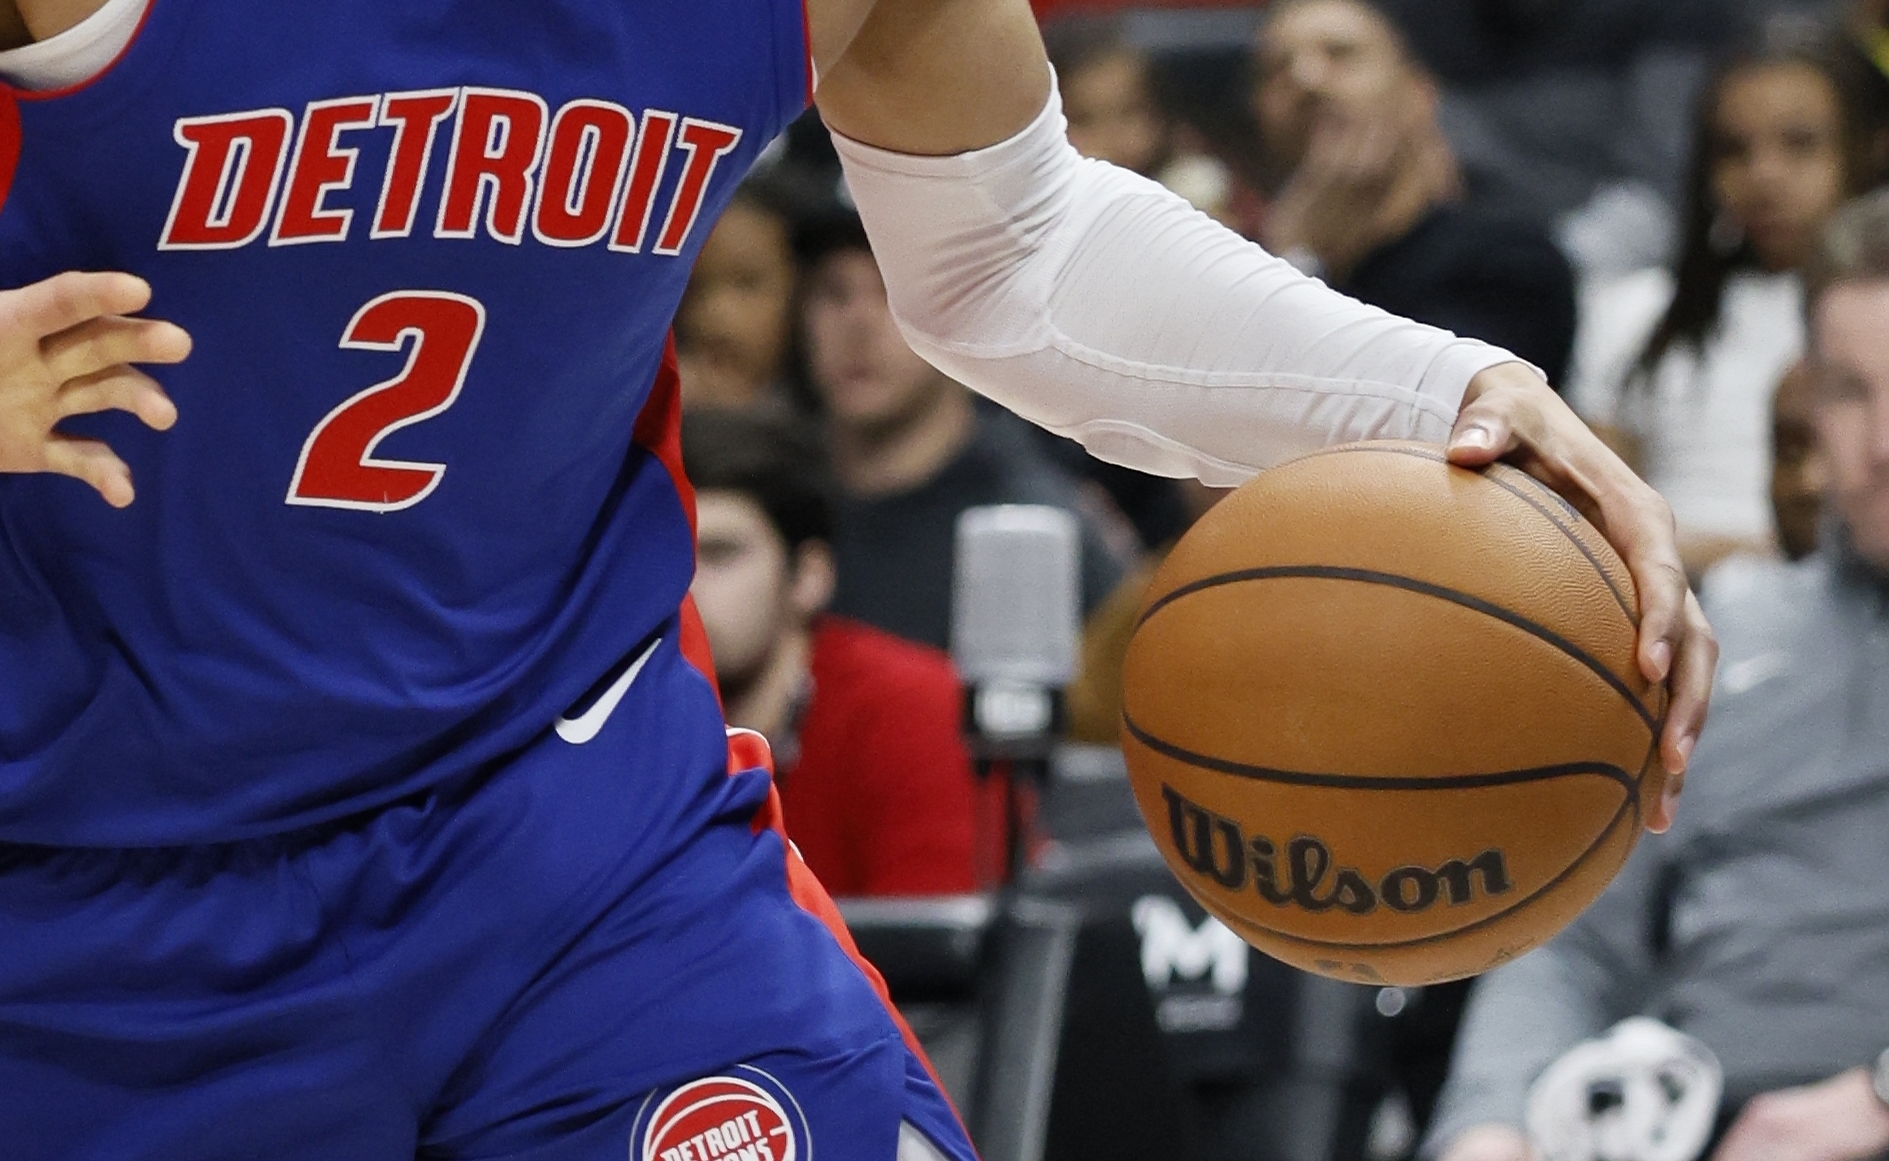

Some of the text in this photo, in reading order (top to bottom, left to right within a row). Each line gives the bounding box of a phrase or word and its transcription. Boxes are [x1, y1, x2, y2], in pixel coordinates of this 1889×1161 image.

[156, 85, 743, 256] DETROIT
[284, 289, 486, 512] 2
[1160, 781, 1510, 917] Wilson
